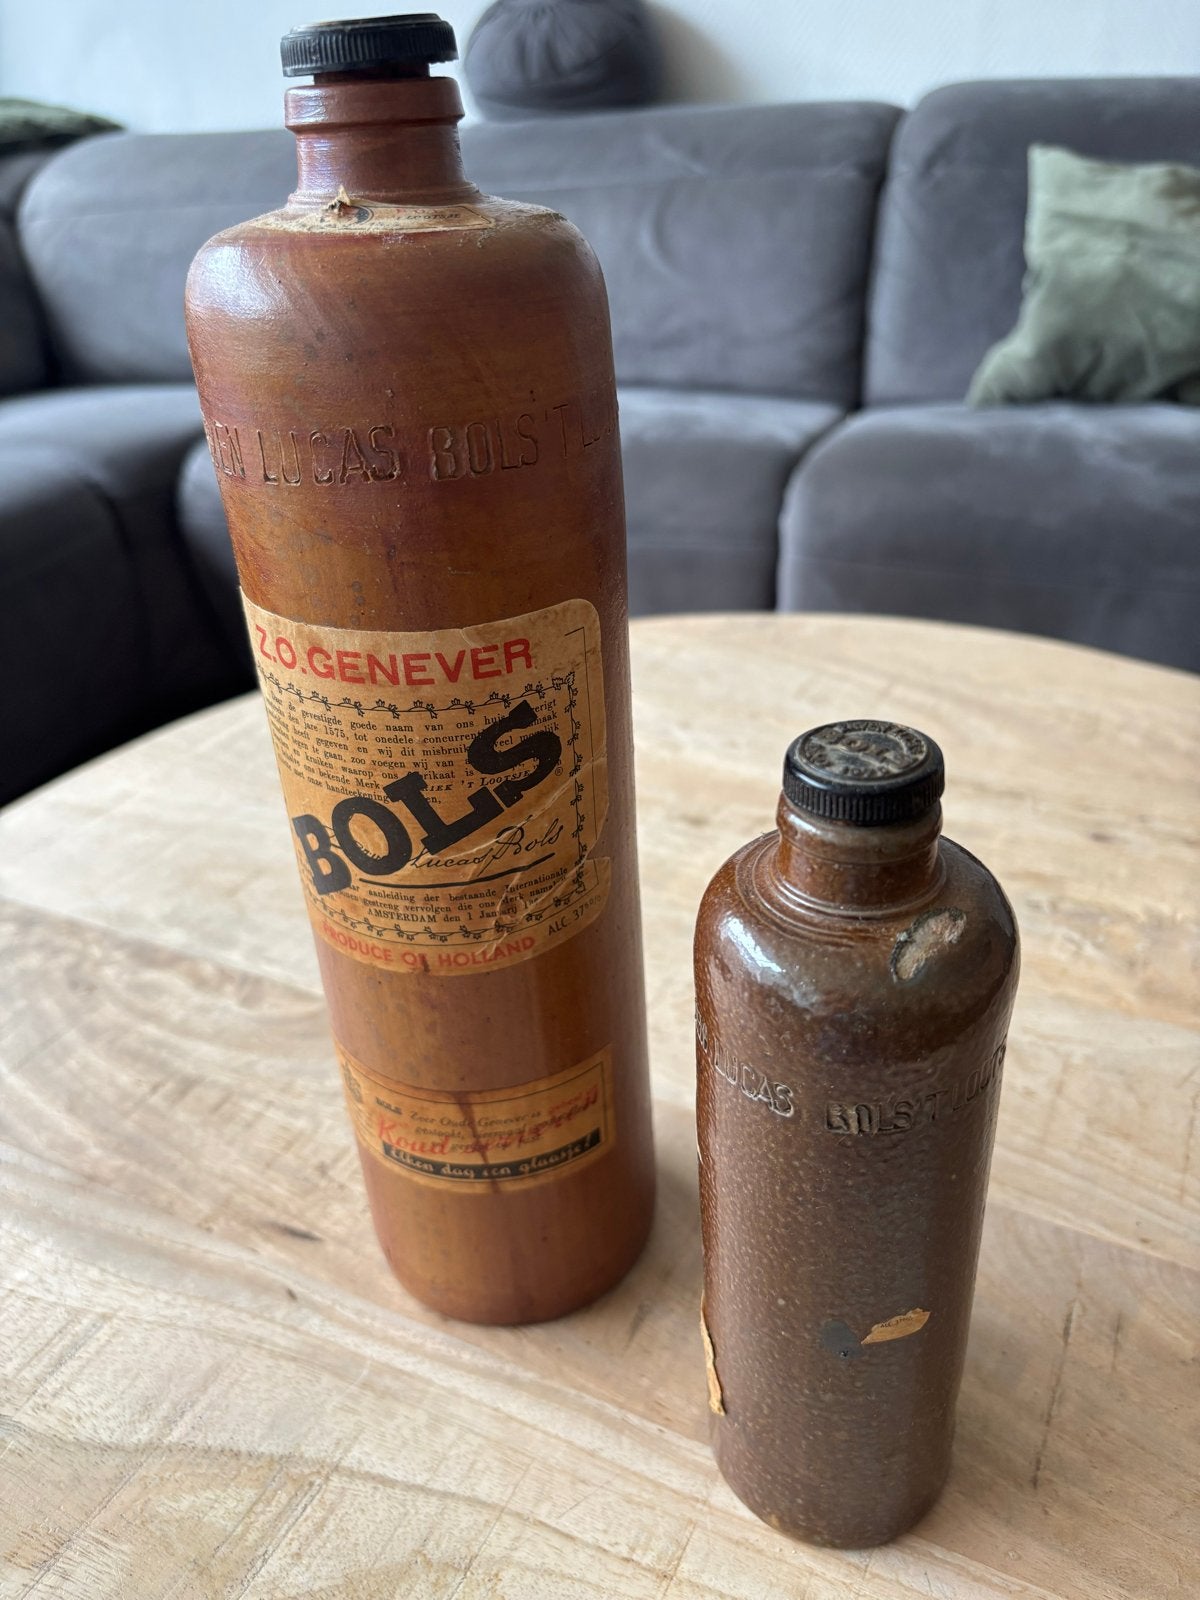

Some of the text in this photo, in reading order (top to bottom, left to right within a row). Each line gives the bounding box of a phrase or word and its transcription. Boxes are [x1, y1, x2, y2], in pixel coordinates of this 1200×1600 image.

[256, 426, 402, 487] LUCAS
[429, 413, 540, 482] BOLS
[255, 623, 533, 687] Z.O.GENEVER
[302, 709, 343, 727] gevestigde
[350, 720, 378, 732] goede
[385, 724, 413, 732] naam
[424, 723, 444, 732] van
[456, 720, 475, 730] ons
[533, 699, 557, 713] erigt
[315, 736, 350, 752] gegeven
[357, 746, 369, 754] en
[377, 746, 394, 759] wij
[400, 747, 415, 757] dit
[422, 743, 473, 757] misbruik
[494, 736, 513, 749] veel
[324, 726, 350, 741] 1575,
[354, 732, 369, 742] tot
[375, 734, 414, 744] onedele
[423, 732, 481, 744] concurren
[305, 754, 335, 770] kruiken
[341, 765, 374, 779] waarop
[381, 771, 398, 780] ons
[407, 770, 456, 783] rikaat
[465, 769, 474, 777] is
[350, 756, 366, 765] zoo
[371, 758, 406, 770] voegen
[413, 759, 428, 771] wij
[436, 759, 454, 768] van
[319, 768, 351, 786] bekende
[355, 777, 381, 790] Merk
[325, 782, 391, 804] handteekening
[292, 699, 563, 899] BOLS
[368, 889, 416, 904] aanleiding
[424, 894, 440, 903] der
[448, 889, 497, 903] bestaande
[503, 867, 568, 895] Internationale
[362, 897, 400, 912] gestreng
[404, 903, 452, 916] vervolgen
[457, 903, 473, 912] die
[478, 900, 496, 909] ons
[368, 908, 439, 923] AMSTERDAM
[443, 914, 461, 924] den
[467, 912, 473, 921] 1
[322, 920, 394, 962] PRODUCE
[437, 936, 536, 968] HOLLAND
[714, 1036, 795, 1118] LUCAS
[824, 1100, 914, 1136] BOLS
